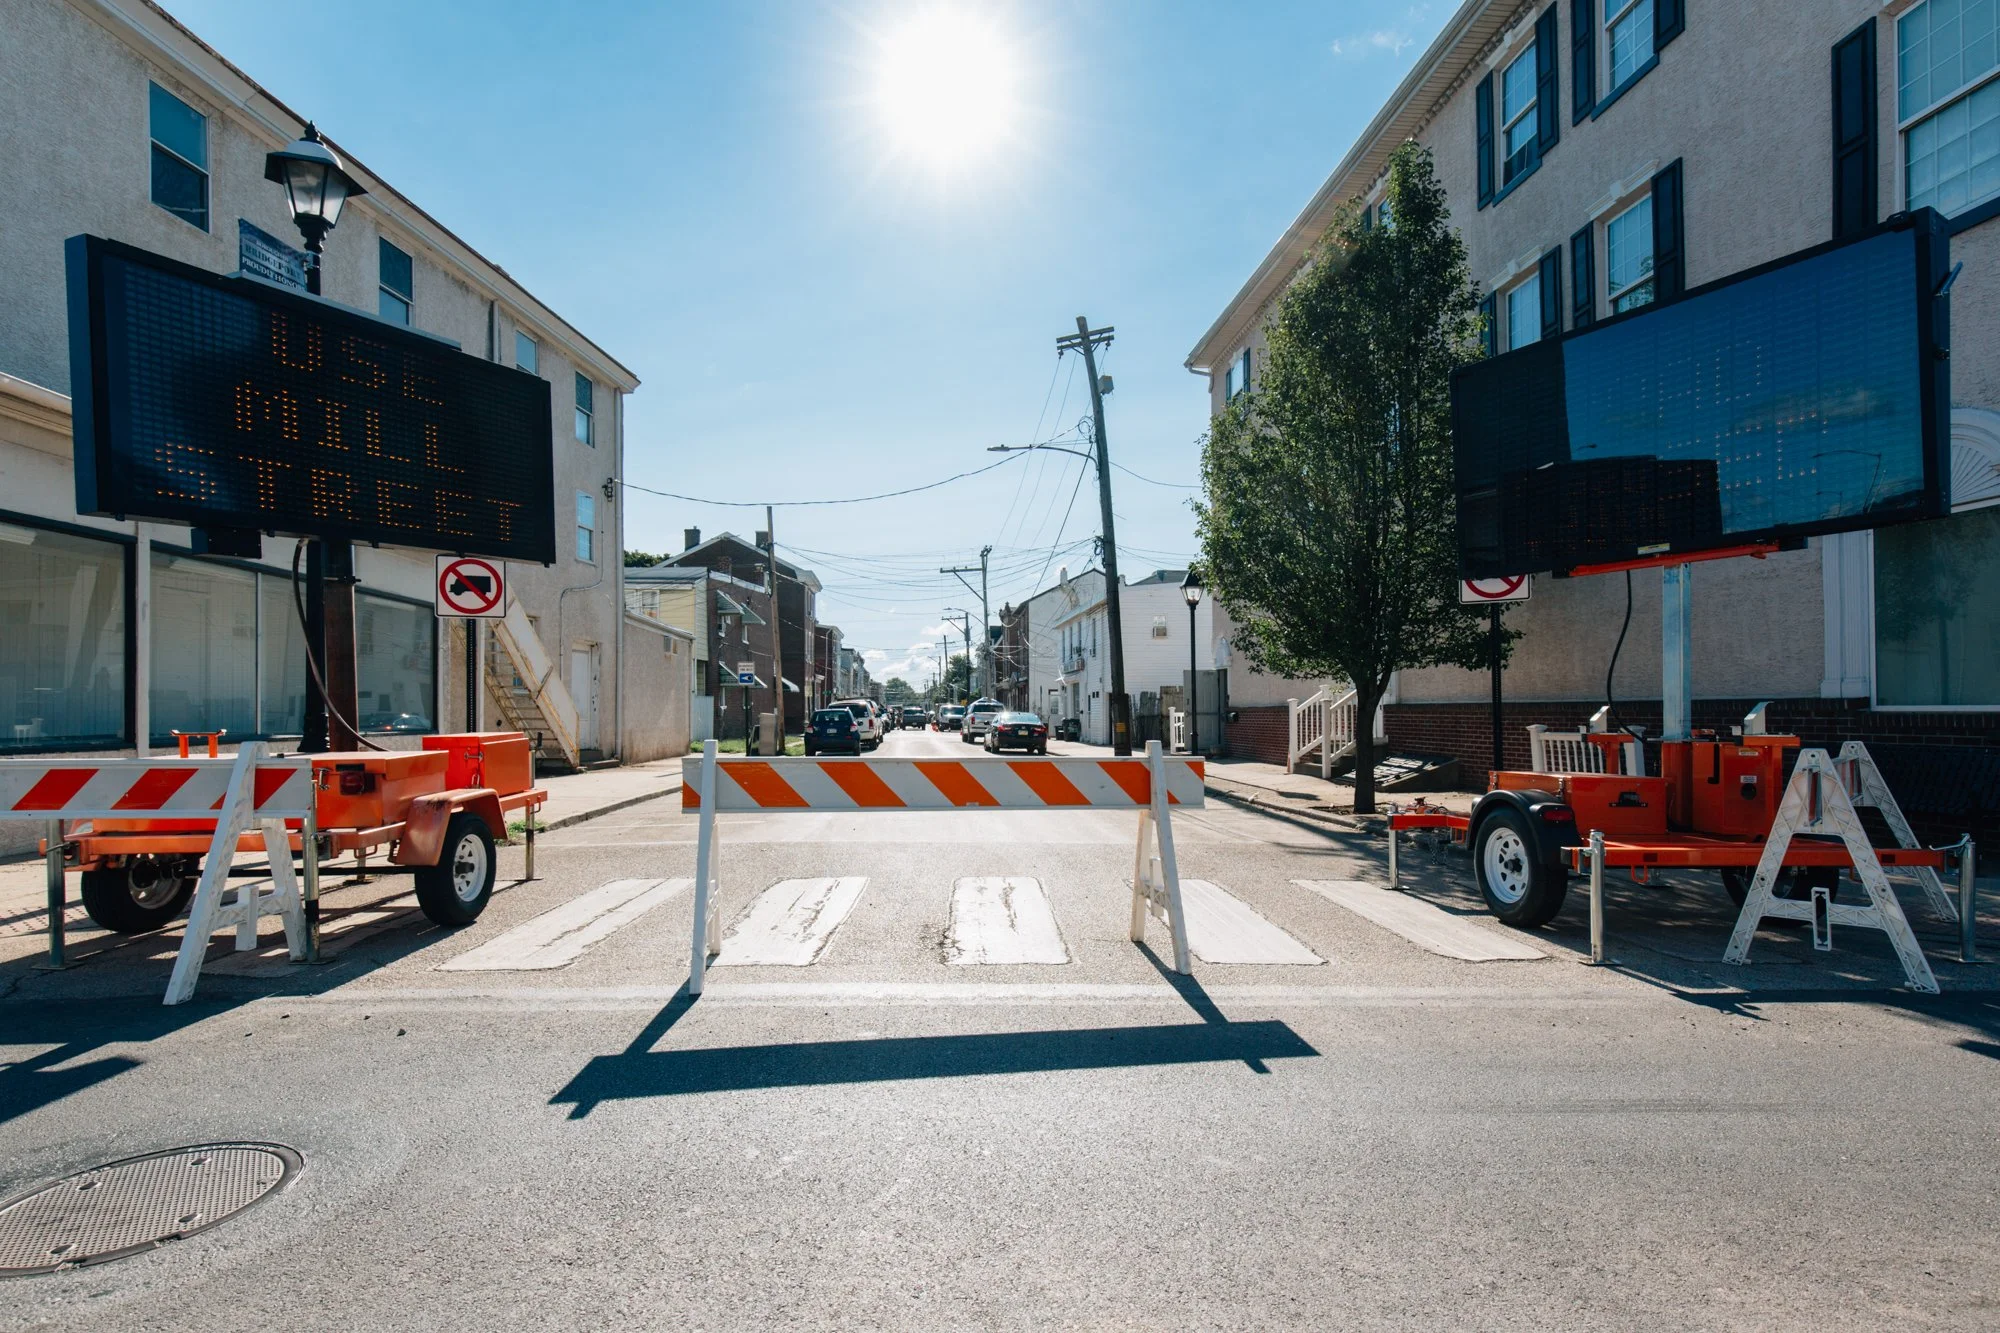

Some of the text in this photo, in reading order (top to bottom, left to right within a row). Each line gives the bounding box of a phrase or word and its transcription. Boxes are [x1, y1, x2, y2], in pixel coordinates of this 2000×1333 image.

[242, 256, 274, 278] PROUDLY
[269, 312, 445, 406] USE
[233, 381, 466, 473] MILL
[154, 443, 521, 541] STREET
